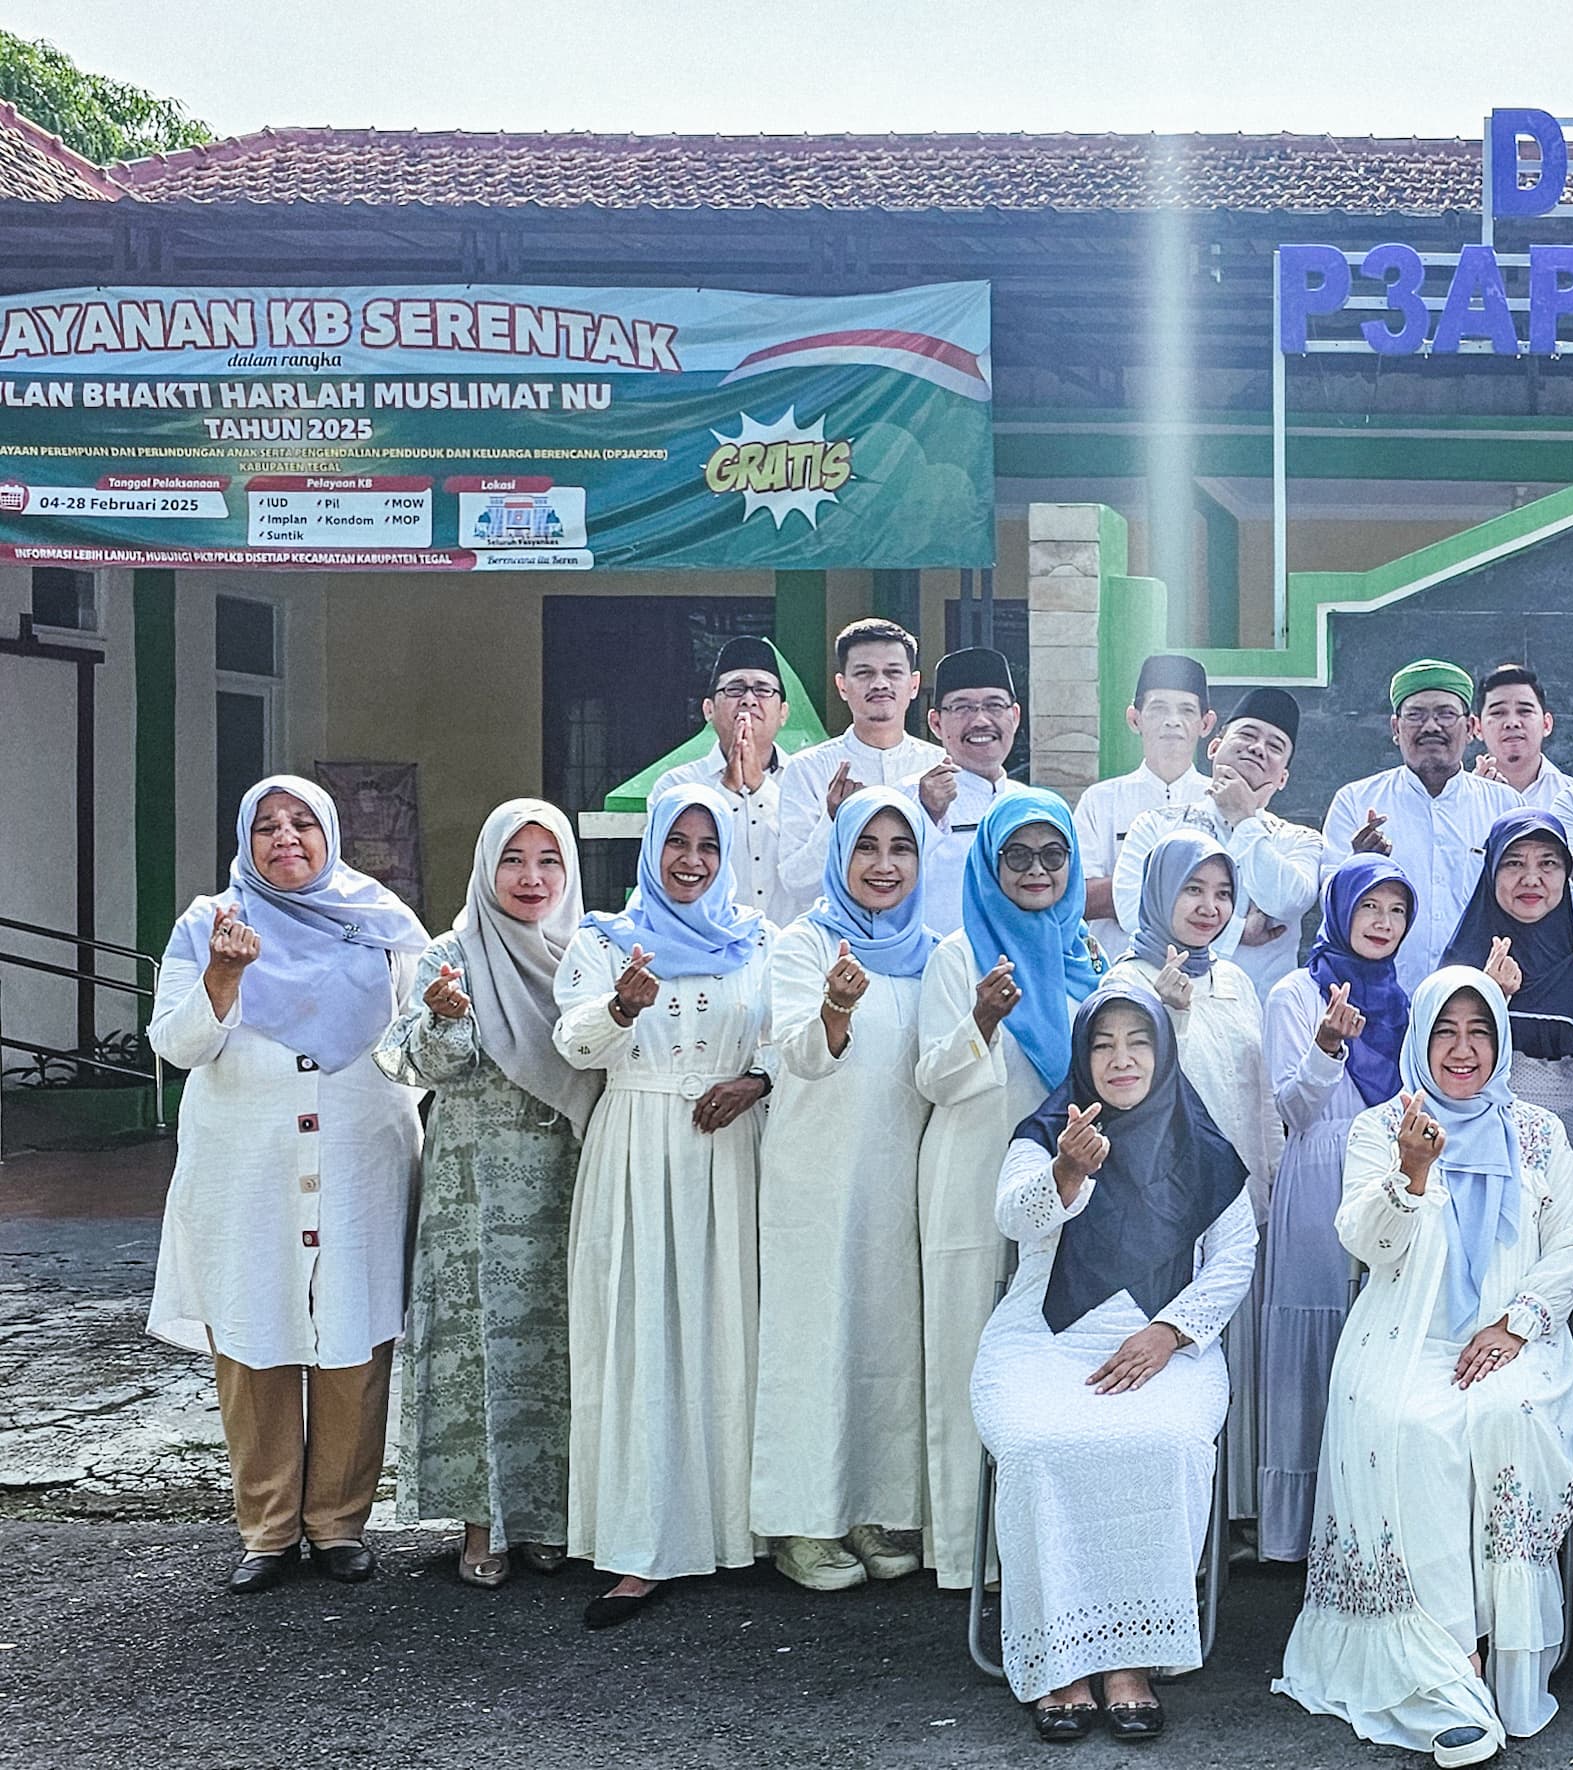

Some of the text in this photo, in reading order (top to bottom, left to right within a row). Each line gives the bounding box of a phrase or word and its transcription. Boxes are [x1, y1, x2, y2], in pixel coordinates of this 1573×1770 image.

[266, 298, 352, 349] KB
[360, 297, 682, 373] SERENTAK
[227, 352, 342, 371] dalam rangka
[0, 381, 612, 410] LAN BHAKTI HARLAH MUSLIMAT NU
[203, 418, 373, 440] TAHUN 2025
[40, 447, 109, 457] PEREMPUAN
[111, 447, 137, 458] DAN
[138, 448, 224, 458] PERLINDUNGAN
[225, 448, 257, 458] ANAK
[259, 448, 293, 458] SERTA
[294, 448, 381, 459] PENGENDALIAN
[383, 448, 444, 459] PENDUDUK
[446, 449, 470, 459] DAN
[472, 449, 532, 460] KELUARGA
[533, 449, 601, 460] BERENCANA
[239, 462, 341, 473] KABUPATEN TEGAL
[704, 439, 853, 494] GRATIS
[108, 477, 220, 490] Tanggal Pelaksanaan
[306, 478, 372, 490] Pelayaan KB
[481, 480, 516, 490] Lokasi
[40, 496, 199, 511] 04-28 Februari 2025
[267, 498, 288, 508] IUD
[325, 498, 340, 508] Pil
[392, 498, 424, 508] MOW
[267, 514, 307, 526] Implan
[325, 514, 374, 526] Kondom
[392, 514, 420, 525] MOP
[266, 530, 304, 541] Suntik
[14, 548, 72, 561] INFORMASI
[73, 549, 102, 561] LEBIH
[104, 550, 146, 564] LANJUT,
[147, 551, 192, 562] HUBUNGI
[245, 552, 290, 564] DISETIAP
[292, 553, 356, 564] KECAMATAN
[357, 553, 418, 565] KABUPATEN
[419, 554, 453, 565] TEGAL
